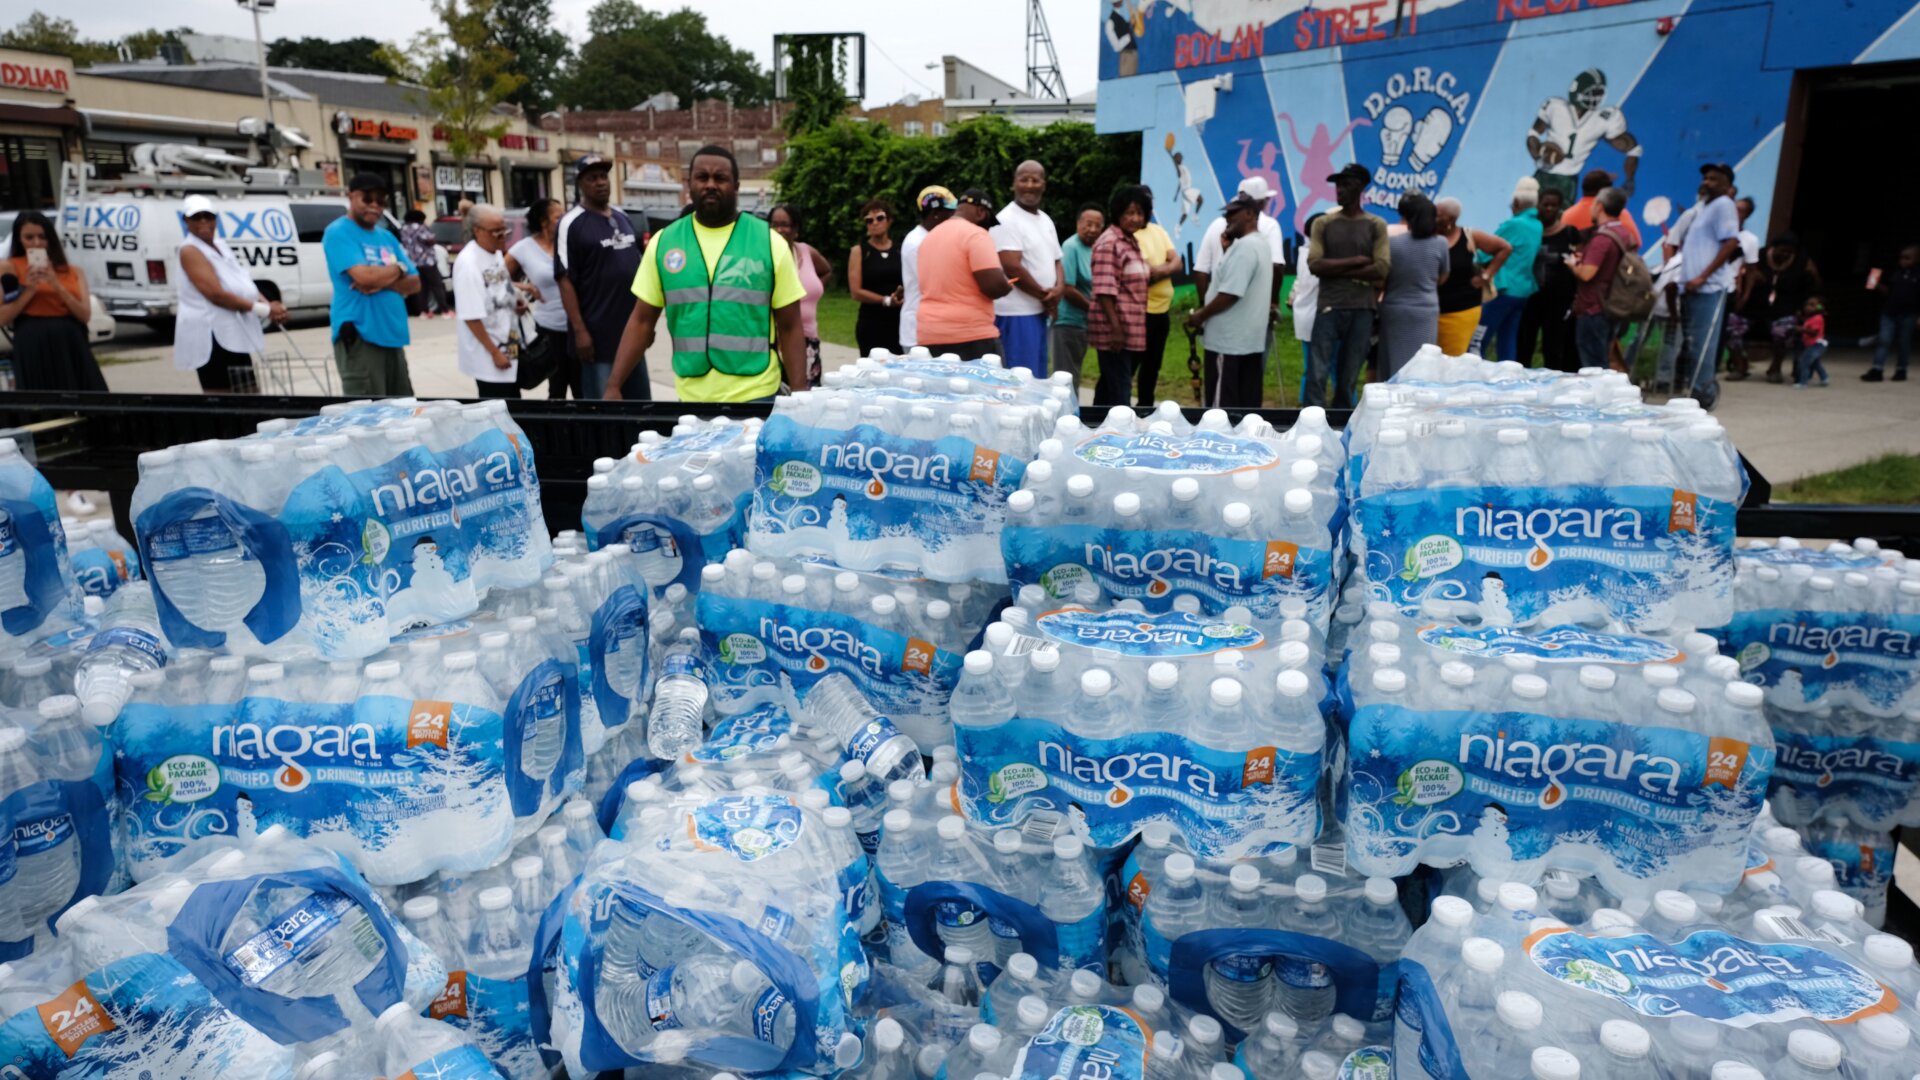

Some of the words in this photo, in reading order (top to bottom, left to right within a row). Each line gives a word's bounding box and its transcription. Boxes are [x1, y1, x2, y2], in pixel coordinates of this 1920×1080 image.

[1174, 21, 1264, 69] BOYLAN
[1294, 0, 1423, 50] STREET
[1363, 66, 1470, 124] D.O.R.C.A.
[1374, 166, 1437, 190] BOXING
[64, 233, 138, 251] NEWS
[786, 463, 813, 474] ECO-AIR
[820, 442, 951, 496] niagara
[975, 456, 994, 471] 24
[892, 485, 935, 501] DRINKING
[938, 490, 969, 506] WATER
[1674, 501, 1692, 515] 24
[393, 513, 450, 537] PURIFIED
[1456, 502, 1645, 561] niagara
[1420, 540, 1450, 550] ECO-AIR
[1420, 547, 1450, 557] PACKAGE
[1267, 552, 1291, 566] 24
[1426, 556, 1448, 565] 100%
[1469, 548, 1523, 565] PURIFIED
[1559, 547, 1626, 566] DRINKING
[1628, 552, 1668, 570] WATER
[1053, 567, 1081, 575] ECO-AIR
[1085, 543, 1243, 596] niagara
[1176, 578, 1226, 604] DRINKING
[1077, 623, 1204, 646] niagara
[1769, 622, 1912, 664] niagara
[760, 616, 884, 676] niagara
[906, 647, 929, 664] 24
[870, 679, 902, 695] WATER
[413, 711, 445, 729] 24
[167, 761, 207, 770] ECO-AIR
[1247, 756, 1270, 772] 24
[1459, 731, 1682, 805] niagara
[1709, 751, 1738, 769] 24
[168, 769, 208, 779] PACKAGE
[369, 768, 414, 784] WATER
[1003, 767, 1034, 776] ECO-AIR
[1003, 773, 1036, 782] PACKAGE
[1038, 740, 1219, 804] niagara
[1414, 773, 1451, 782] PACKAGE
[1415, 766, 1450, 775] ECO-AIR
[180, 780, 206, 790] 100%
[1012, 779, 1035, 788] 100%
[1422, 783, 1447, 793] 100%
[1053, 777, 1102, 803] PURIFIED
[1139, 786, 1201, 811] DRINKING
[1203, 803, 1242, 818] WATER
[1471, 777, 1536, 804] PURIFIED
[1573, 787, 1651, 815] DRINKING
[1654, 807, 1699, 823] WATER
[1799, 977, 1845, 991] WATER
[51, 996, 94, 1034] 24
[68, 1020, 101, 1043] BOTTLES
